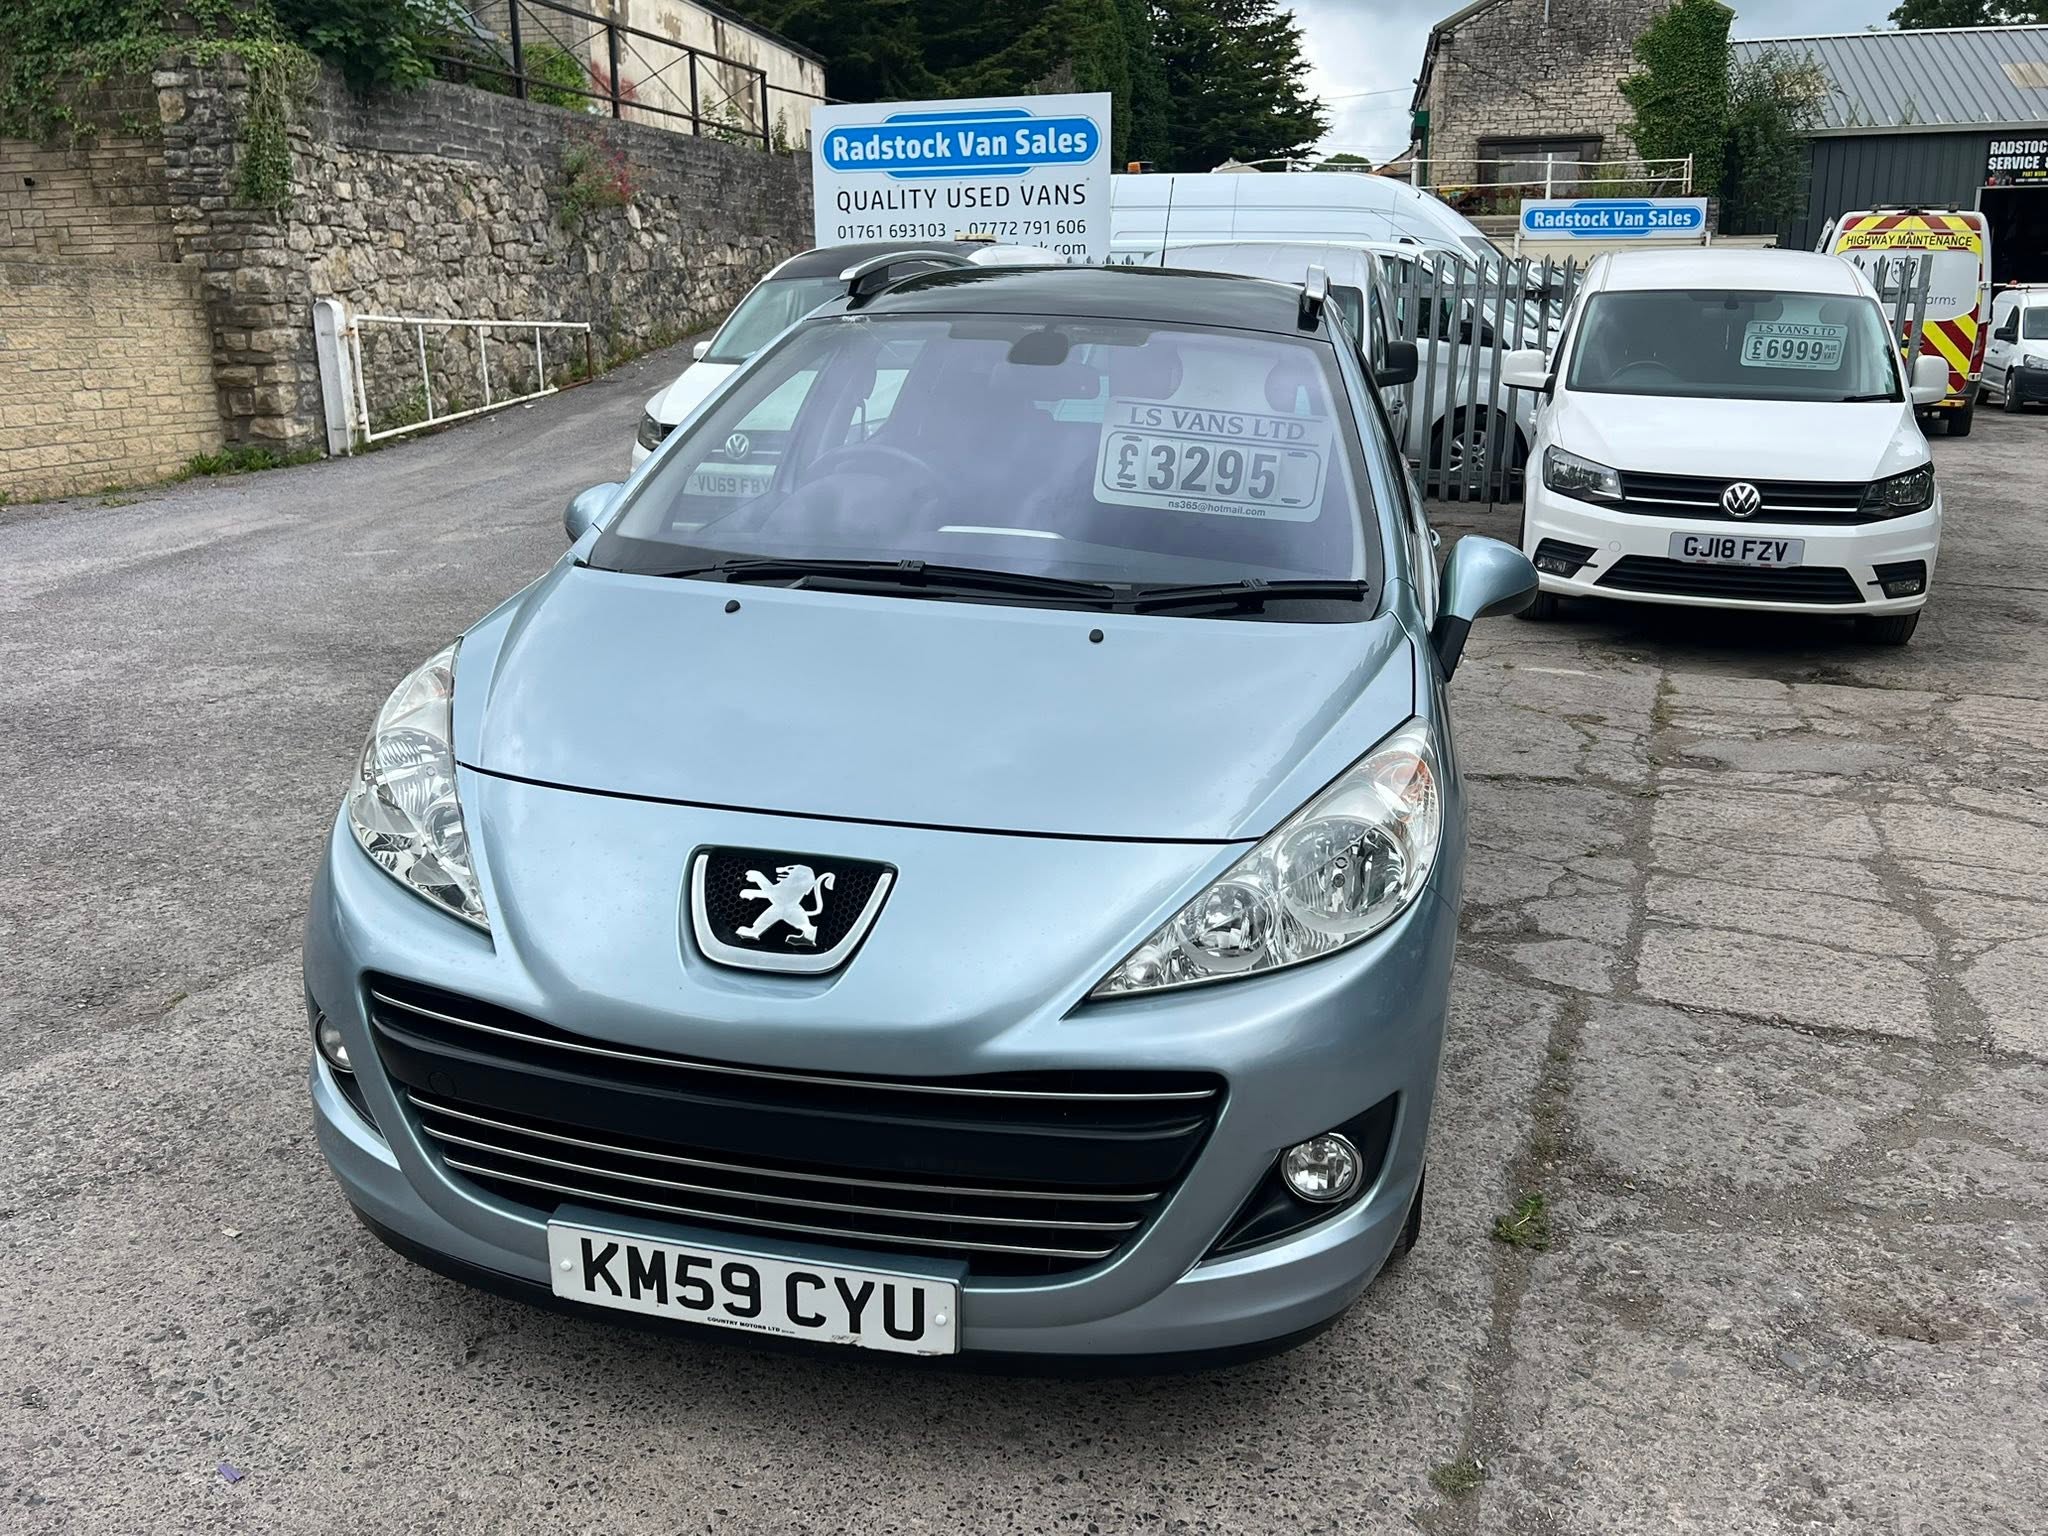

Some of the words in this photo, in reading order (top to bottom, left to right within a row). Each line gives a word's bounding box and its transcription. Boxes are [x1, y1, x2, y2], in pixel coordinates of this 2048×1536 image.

[832, 131, 951, 162] Radstock
[957, 132, 1007, 158] Van
[1014, 127, 1087, 156] Sales
[1990, 140, 2048, 155] RADSTOC
[1988, 155, 2040, 170] SERVICE
[836, 188, 937, 214] QUALITY
[946, 186, 1010, 208] USED
[1020, 183, 1086, 206] VANS
[1534, 211, 1610, 228] Radstock
[1614, 211, 1644, 227] Van
[1648, 209, 1692, 226] Sales
[837, 224, 883, 239] 01761
[889, 222, 946, 238] 693103
[969, 220, 1018, 236] 07772
[1023, 220, 1050, 235] 791
[1056, 219, 1086, 234] 606
[1846, 235, 1895, 246] HIGHWAY
[1897, 235, 1973, 247] MAINTENANCE
[1926, 296, 1957, 306] arms
[1759, 325, 1774, 333] LS
[1778, 325, 1809, 335] VANS
[1813, 327, 1837, 336] LTD
[1823, 352, 1836, 360] VAT
[1130, 406, 1162, 427] LS
[1171, 410, 1244, 435] VANS
[1253, 418, 1305, 440] LTD
[699, 475, 736, 493] VU69
[1168, 501, 1266, 516] ns365@hotmail.com
[1683, 536, 1736, 559] GJ18
[1741, 539, 1788, 562] FZV
[580, 1237, 761, 1319] KM59
[785, 1271, 926, 1342] CYU
[708, 1317, 737, 1326] COUNTRY
[740, 1322, 766, 1330] MOTORS
